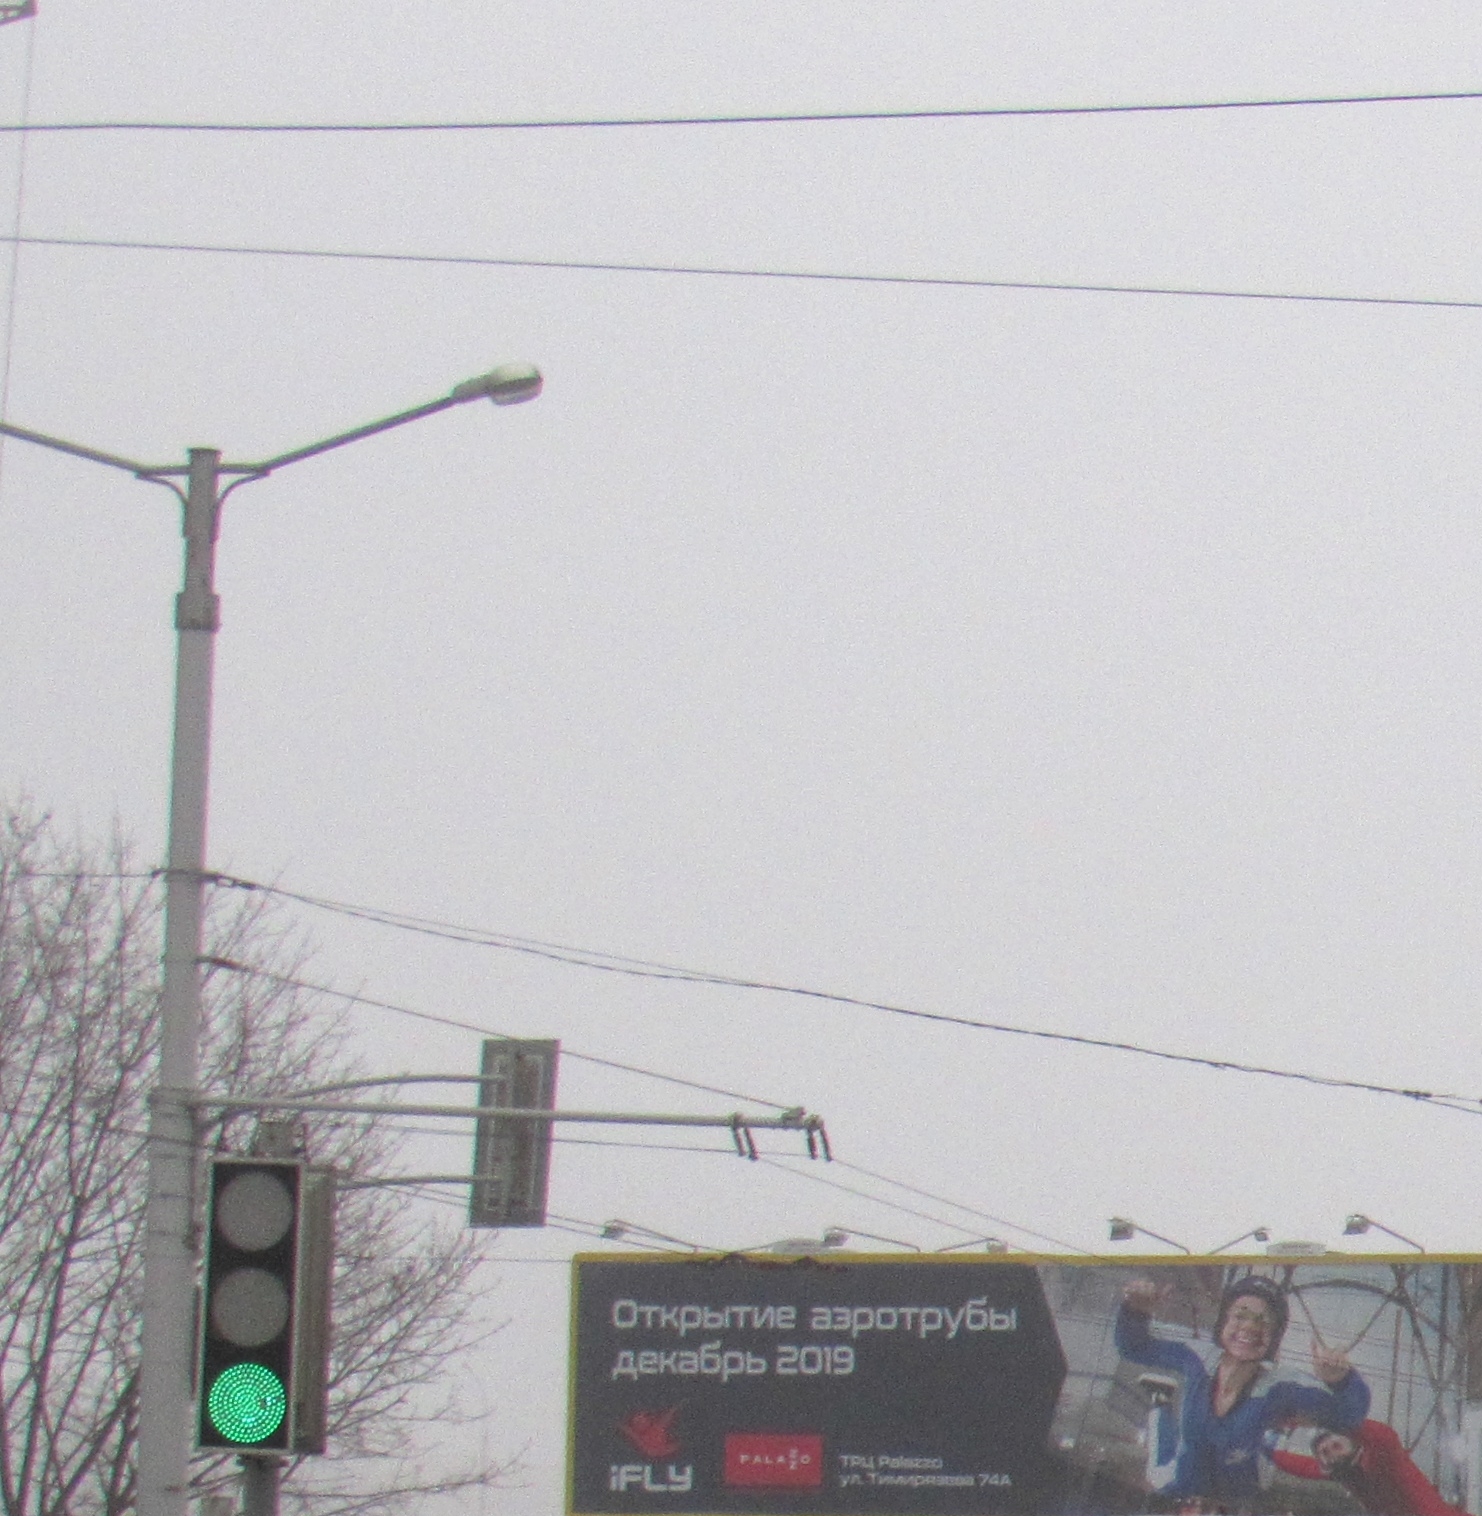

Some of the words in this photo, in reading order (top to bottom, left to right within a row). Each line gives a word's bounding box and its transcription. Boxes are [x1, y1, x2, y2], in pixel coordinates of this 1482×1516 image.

[612, 1299, 797, 1337] Открытие
[811, 1296, 1018, 1339] аэротрубы
[611, 1340, 768, 1383] декабрь
[776, 1345, 854, 1375] 2019
[609, 1464, 692, 1491] iFLY
